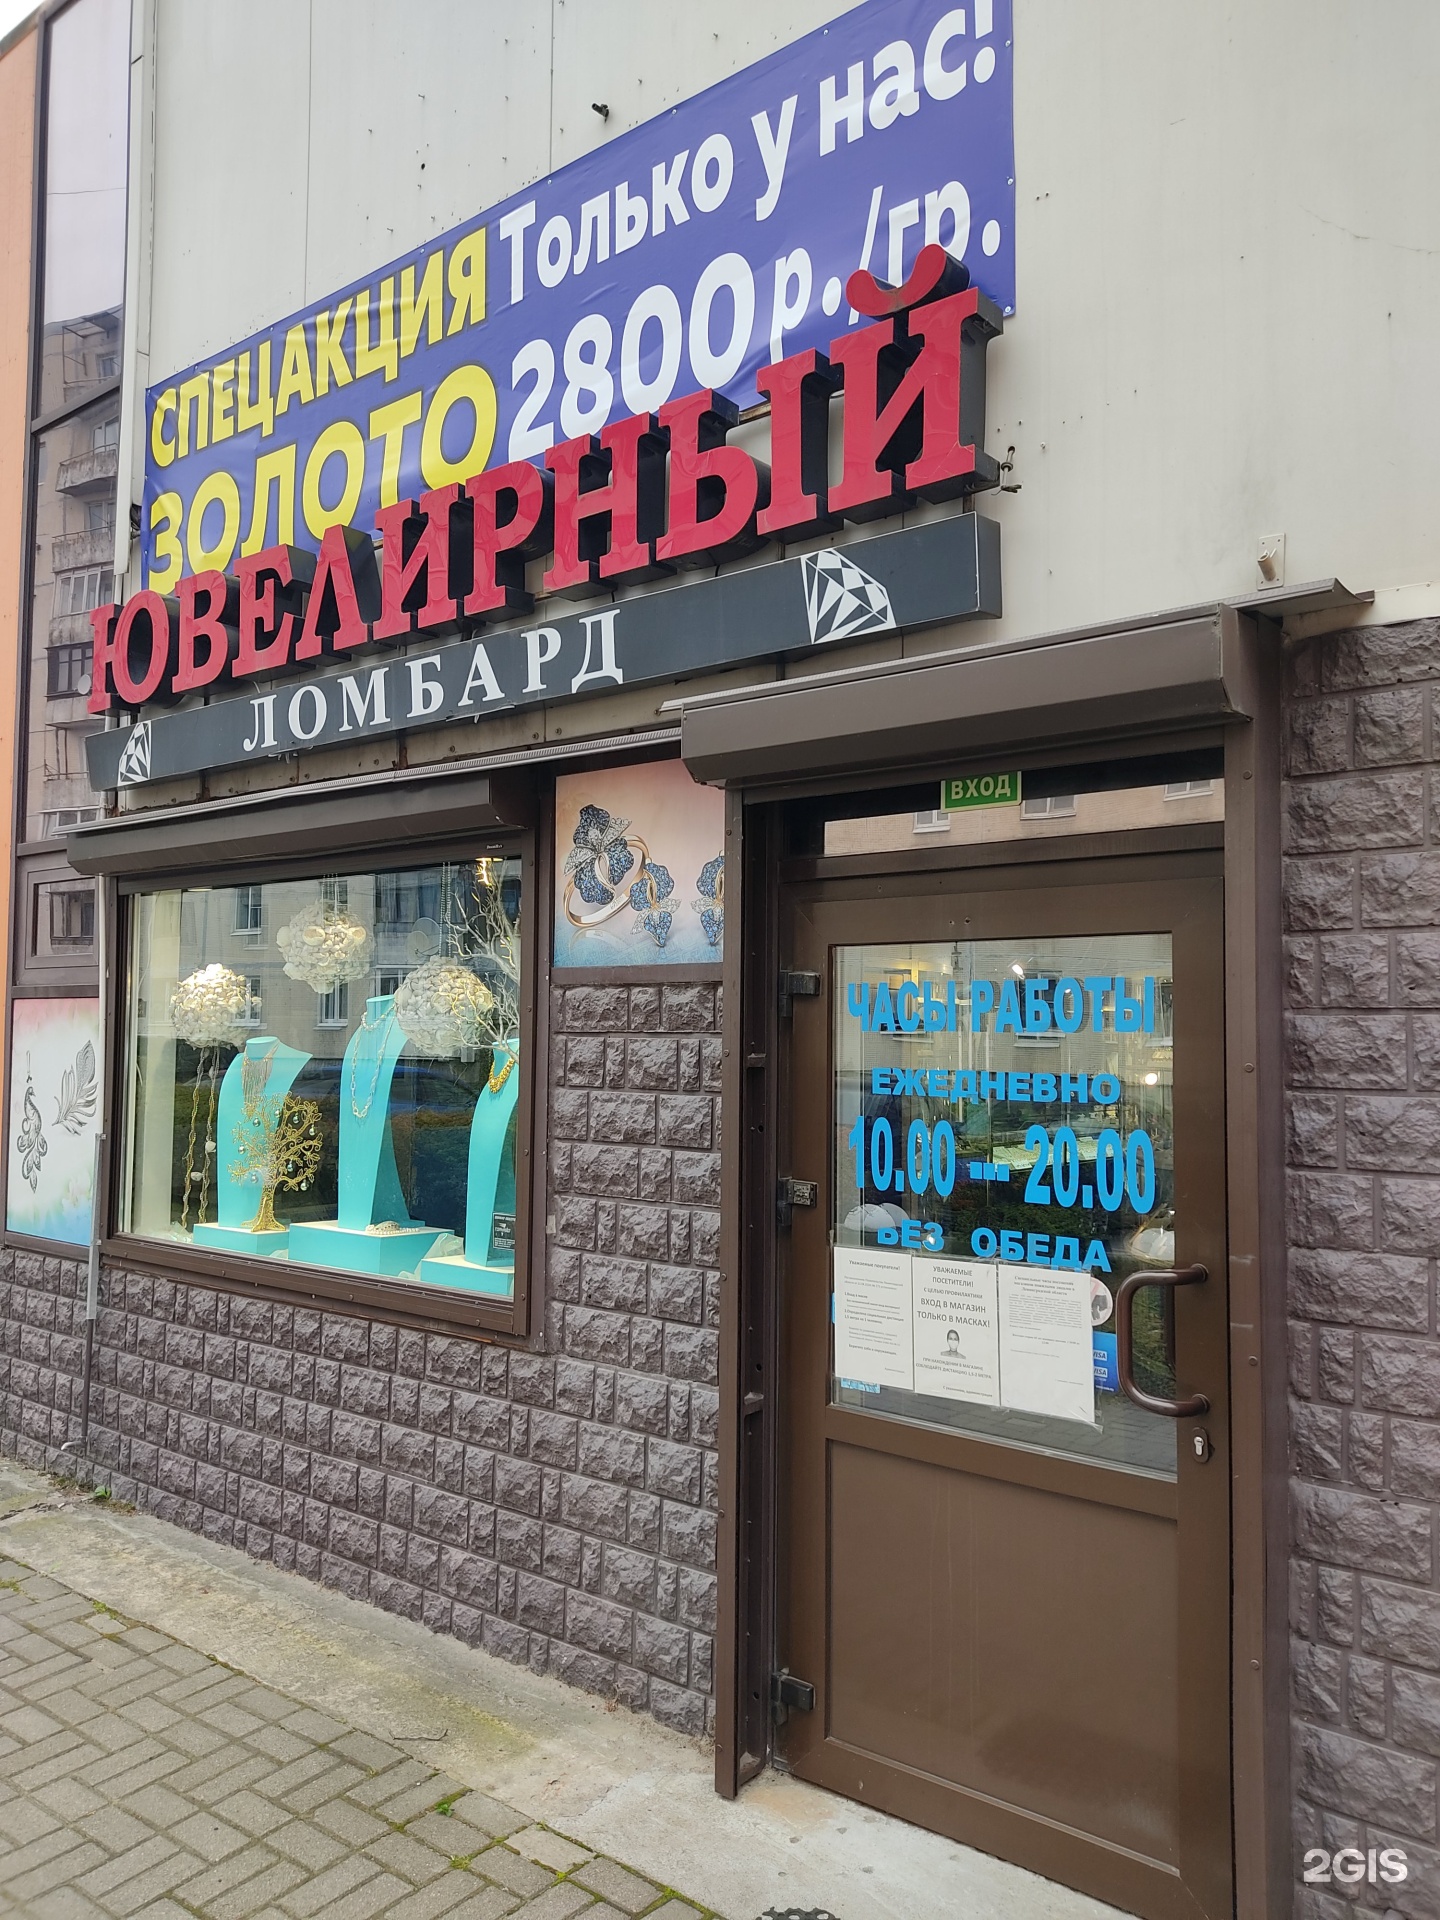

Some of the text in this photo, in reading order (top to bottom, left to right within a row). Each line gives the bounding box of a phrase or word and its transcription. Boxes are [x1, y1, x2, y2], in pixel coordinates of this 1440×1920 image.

[152, 0, 996, 467] СПЕЦАКЦИЯ Только у нас!
[88, 244, 980, 714] ЮВЕЛИРНЫЙ
[149, 365, 497, 597] ЗОЛОТО
[242, 610, 623, 752] ЛОМБАРД
[951, 774, 1011, 800] ВХОД
[848, 977, 1155, 1034] ЧАСЫ РАБОТЫ
[872, 1068, 1121, 1104] ЕЖЕДНЕВНО
[849, 1115, 955, 1197] 10.00
[1024, 1125, 1156, 1214] 20.00
[933, 1266, 973, 1276] УВАЖАЕМЫЕ
[971, 1227, 1112, 1273] ОБЕДА
[920, 1298, 941, 1309] ВХОД
[949, 1302, 986, 1313] МАГАЗИН
[932, 1277, 974, 1288] ПОСЕТИТЕЛИ!
[917, 1311, 947, 1322] ТОЛЬКО
[955, 1316, 990, 1328] МАСКАХ!
